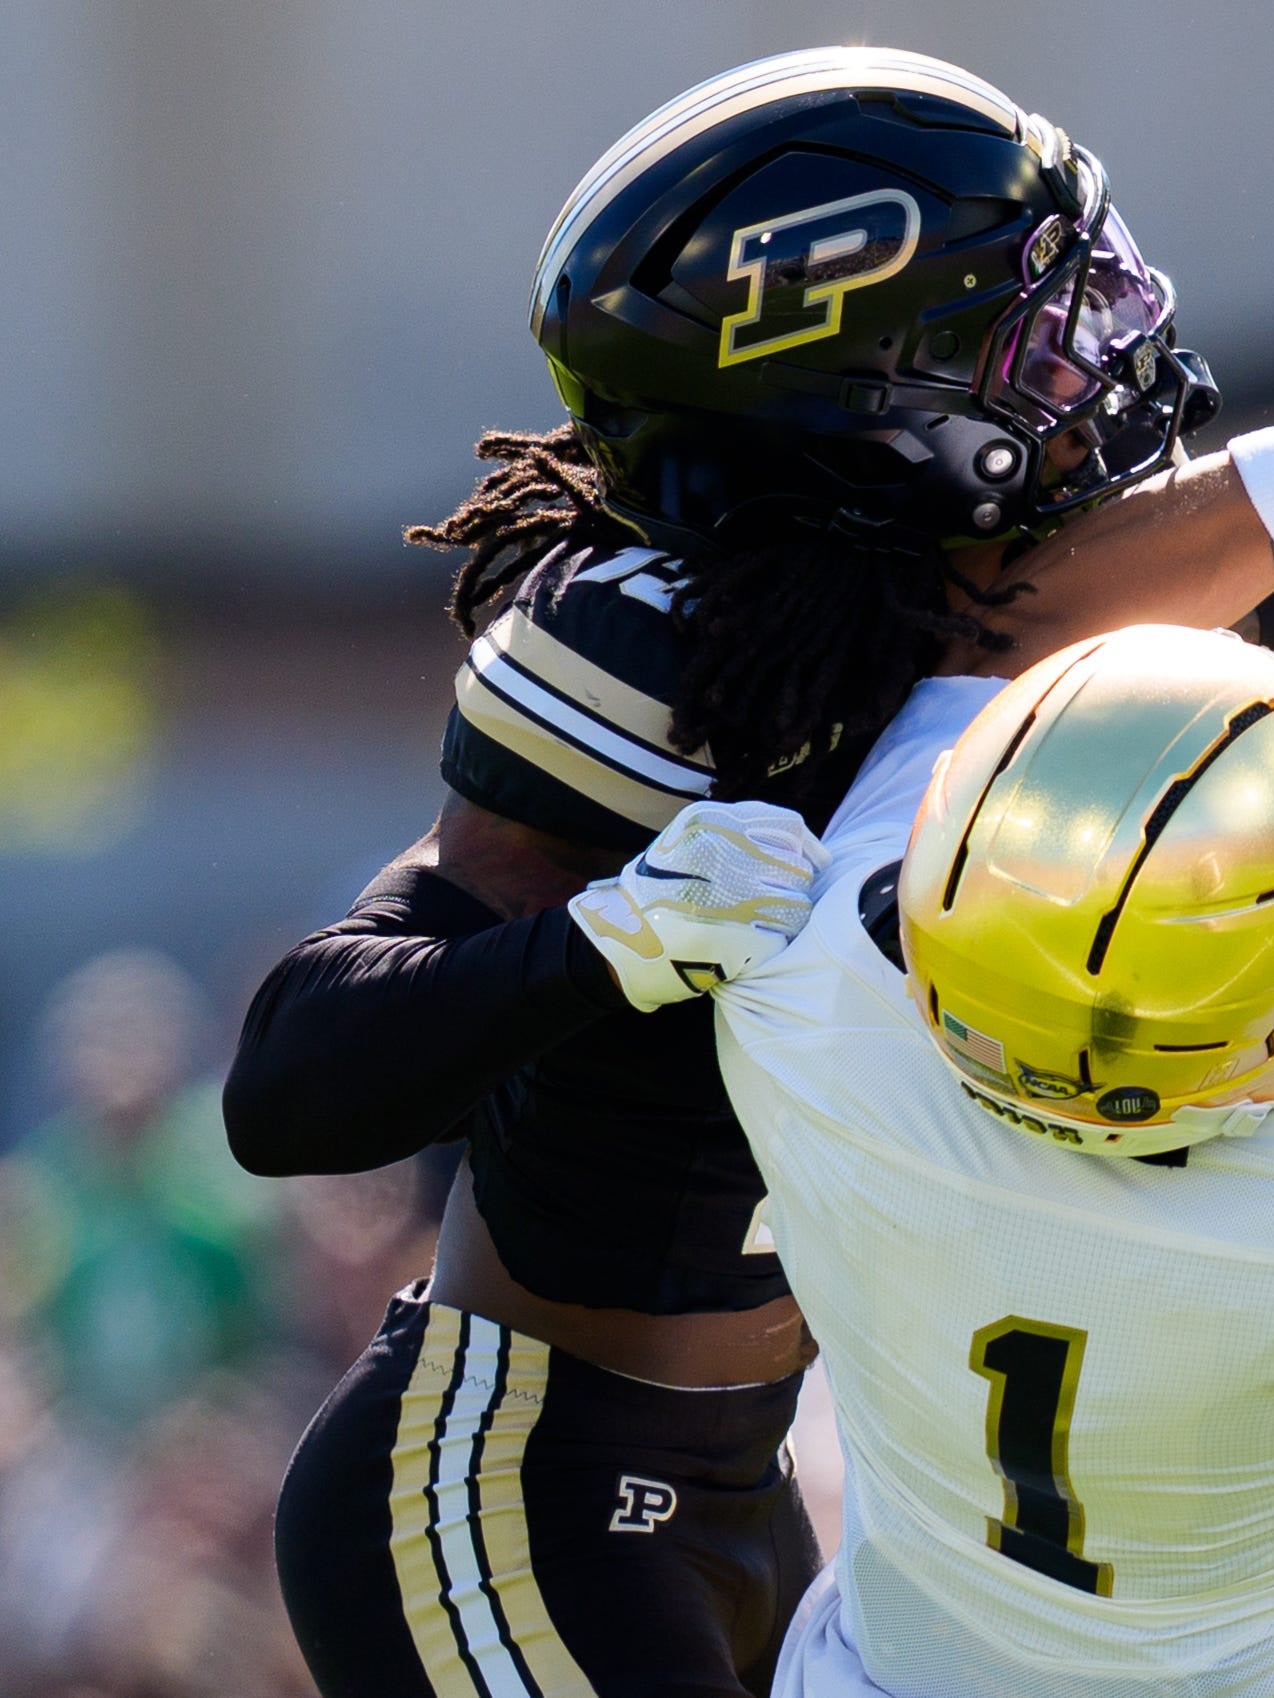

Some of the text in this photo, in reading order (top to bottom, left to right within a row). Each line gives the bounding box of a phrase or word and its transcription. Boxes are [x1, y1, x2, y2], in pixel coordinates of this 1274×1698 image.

[717, 189, 922, 369] P
[1023, 1074, 1069, 1096] NCAA
[608, 1475, 678, 1533] P
[968, 1314, 1115, 1599] 1
